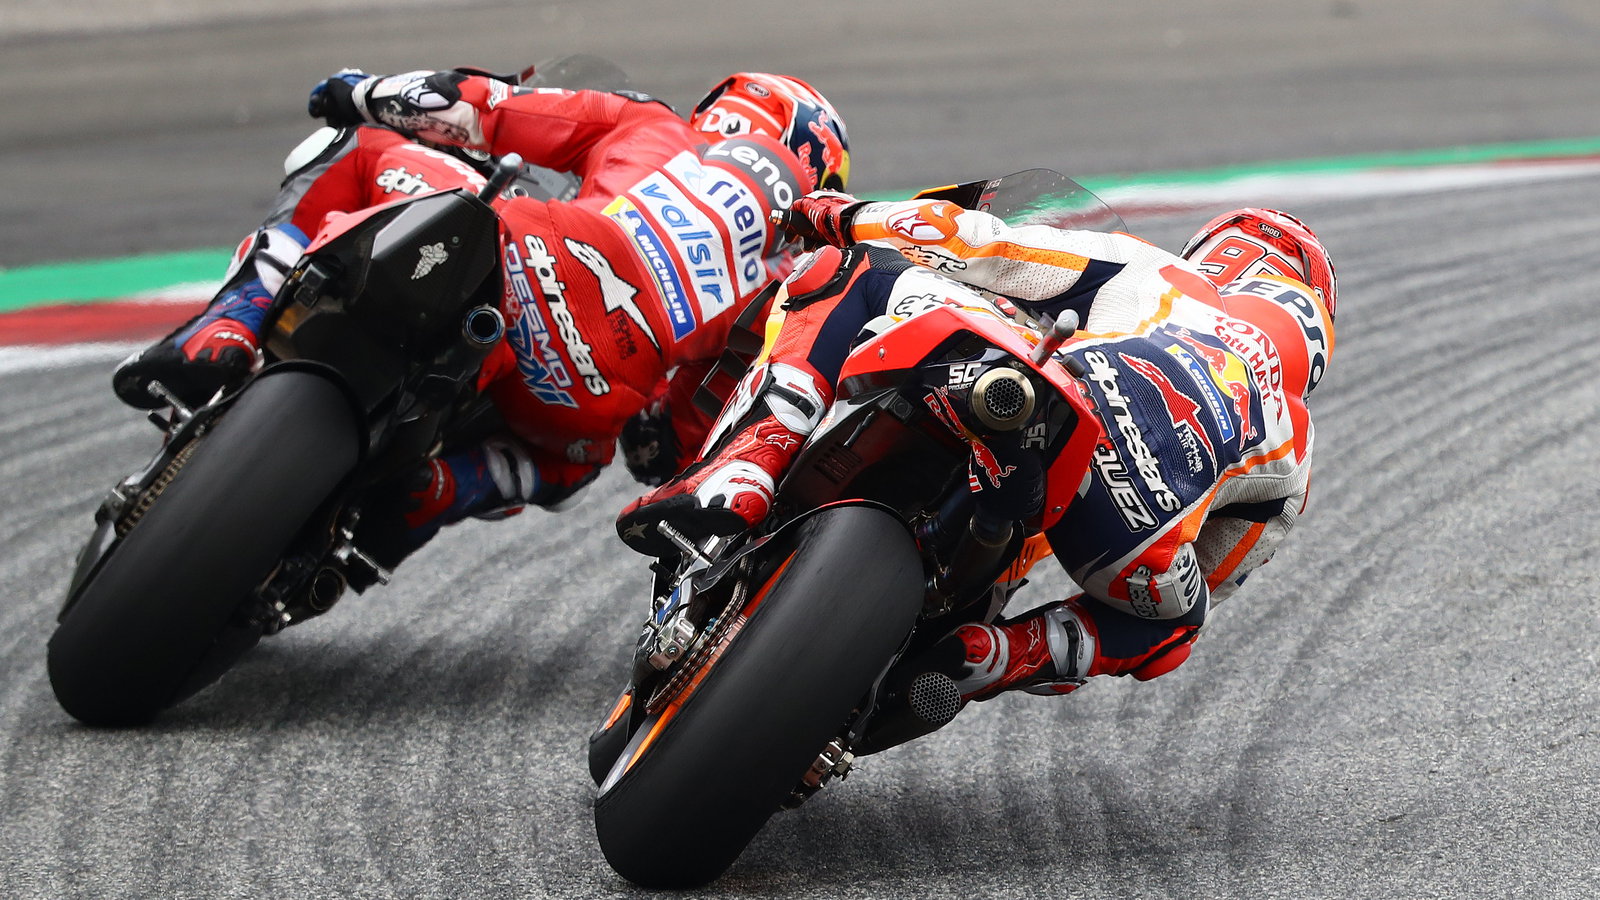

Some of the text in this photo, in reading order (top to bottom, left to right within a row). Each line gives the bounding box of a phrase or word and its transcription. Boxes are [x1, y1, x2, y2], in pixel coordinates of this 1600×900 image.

[705, 141, 794, 210] Leno
[640, 183, 724, 304] valsir
[707, 180, 764, 283] riello
[1259, 223, 1282, 239] SHOEI
[637, 234, 688, 325] MICHELIN
[524, 234, 612, 396] alpinestars
[1214, 325, 1251, 354] Satu
[948, 363, 982, 385] SC
[948, 382, 974, 391] PROJECT
[1190, 367, 1230, 431] MICHELIN
[1084, 351, 1182, 513] alpinestars
